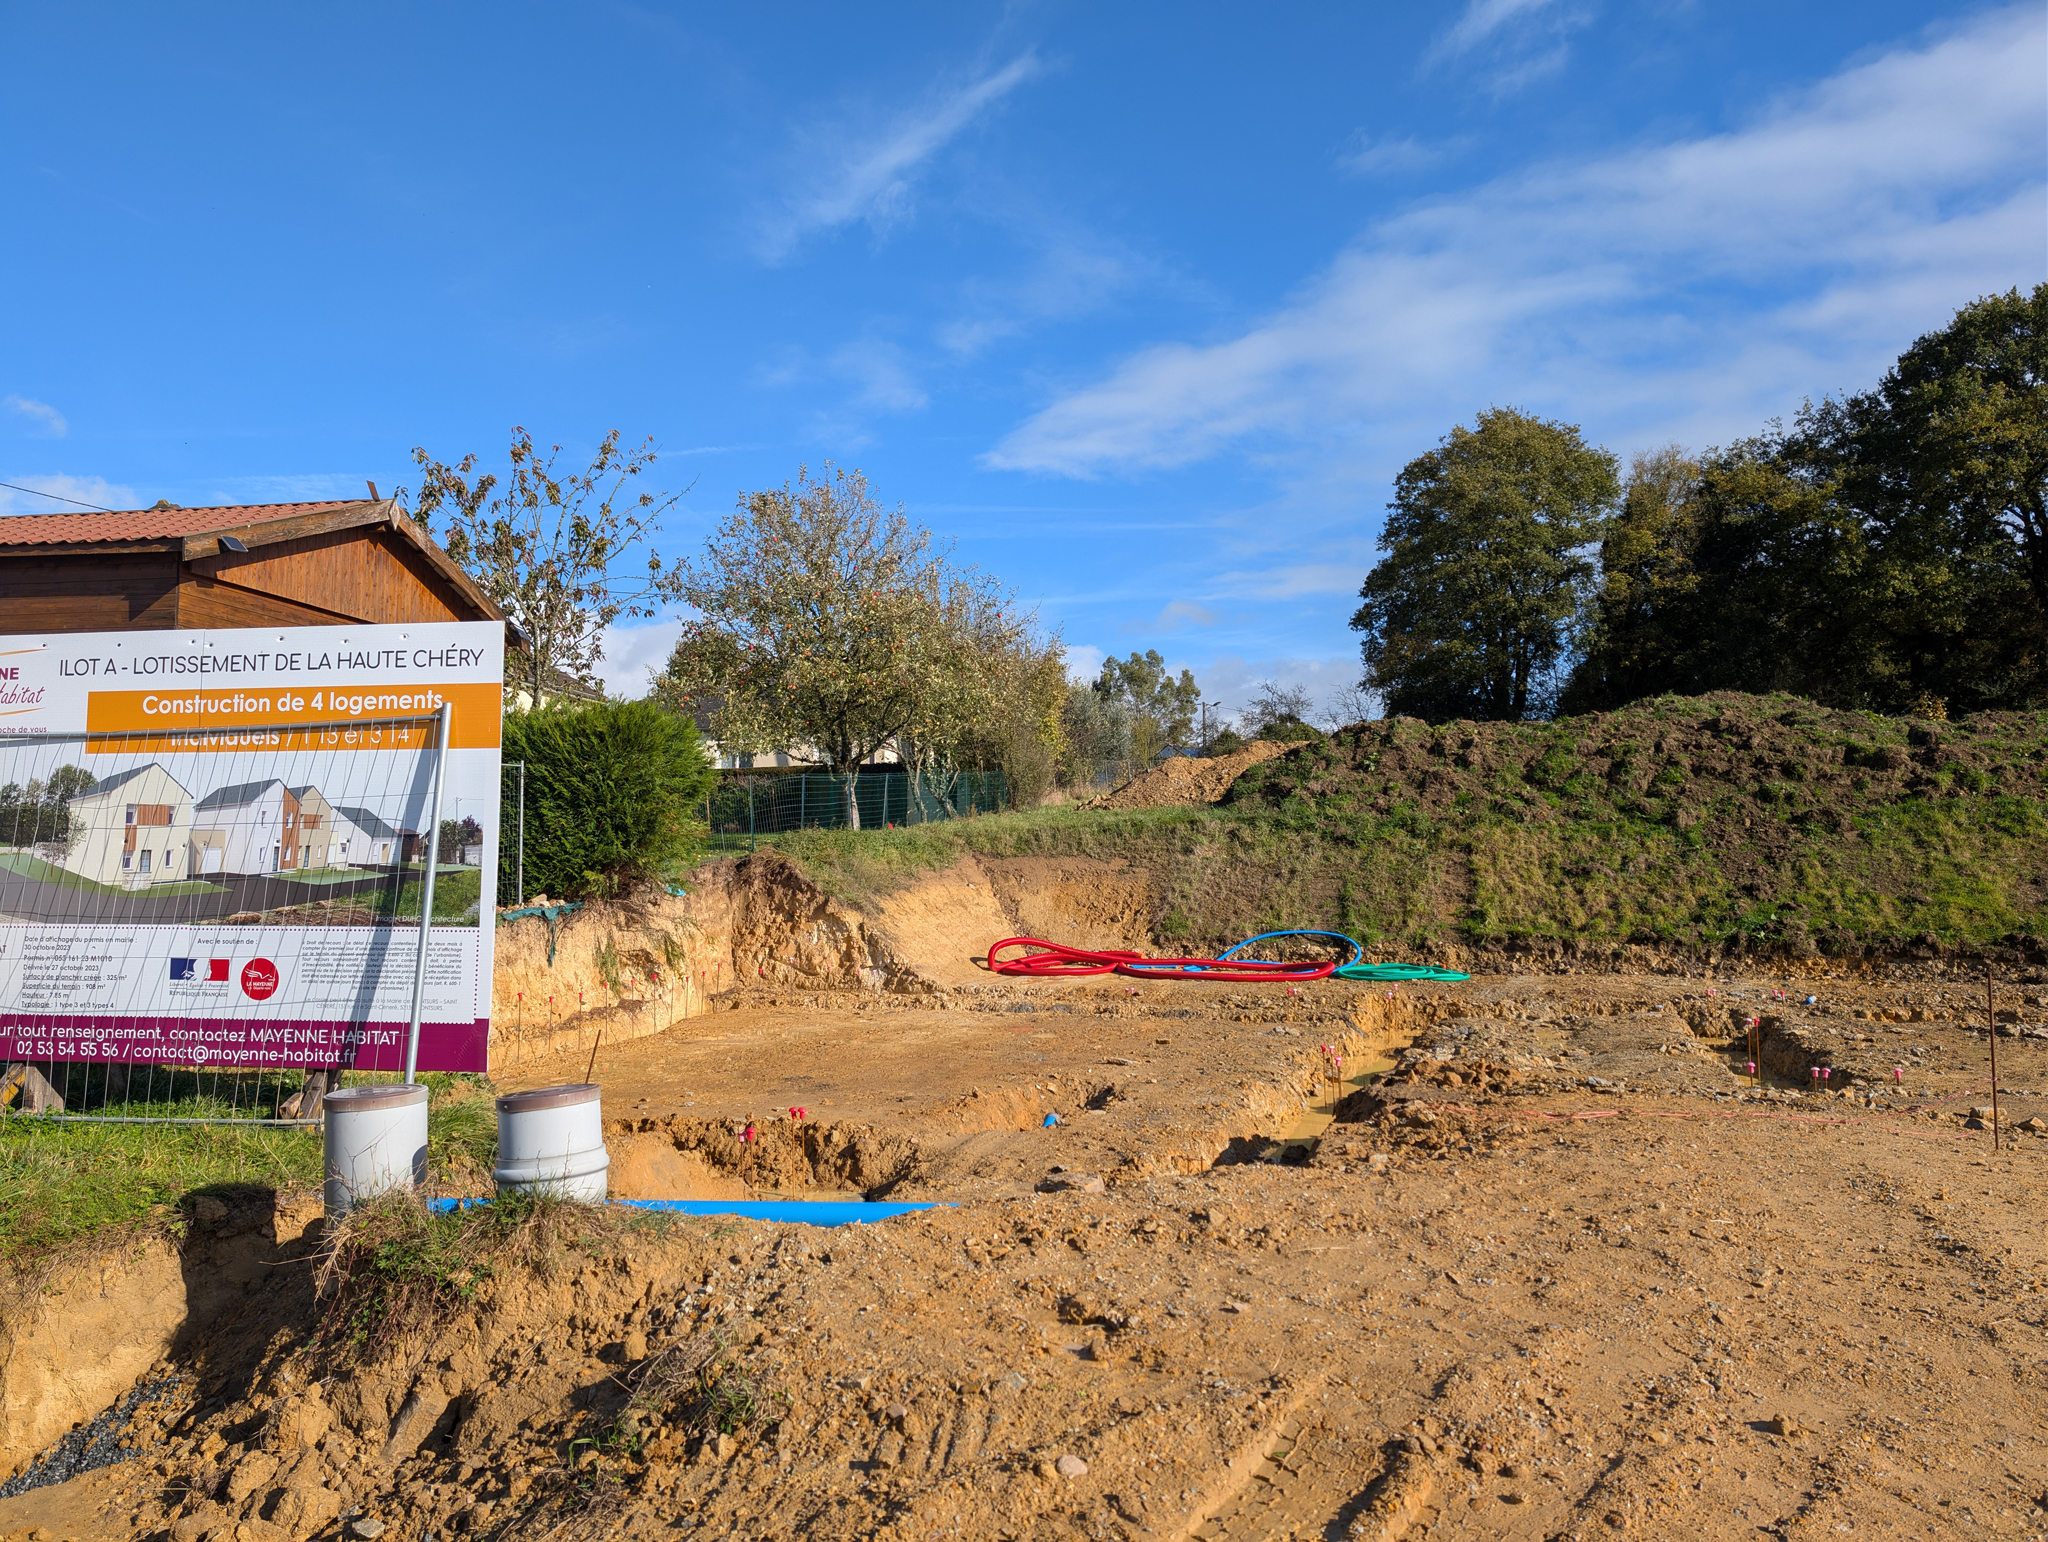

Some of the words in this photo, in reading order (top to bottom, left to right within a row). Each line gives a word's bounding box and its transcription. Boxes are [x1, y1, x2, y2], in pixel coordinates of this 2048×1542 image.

[60, 658, 100, 676] ILOT
[104, 658, 117, 676] A
[133, 654, 270, 675] LOTISSEMENT
[274, 652, 302, 671] DE
[307, 652, 331, 670] LA
[337, 650, 408, 670] HAUTE
[412, 643, 484, 668] CHÉRY
[142, 694, 270, 715] Construction
[277, 693, 304, 712] de
[310, 692, 323, 711] 4
[329, 689, 443, 715] logements
[344, 724, 365, 744] et
[370, 724, 383, 744] 3
[389, 724, 409, 743] T4
[18, 1024, 46, 1037] tout
[51, 1025, 165, 1042] renseignement,
[170, 1028, 246, 1042] contactez
[250, 1028, 328, 1044] MAYENNE
[333, 1030, 400, 1045] HABITAT
[17, 1041, 32, 1055] 02
[37, 1041, 53, 1055] 53
[58, 1042, 75, 1056] 54
[80, 1042, 97, 1056] 55
[102, 1043, 118, 1057] 56
[122, 1043, 130, 1058] /
[134, 1044, 356, 1064] contact@mayenne-habitat.fr
